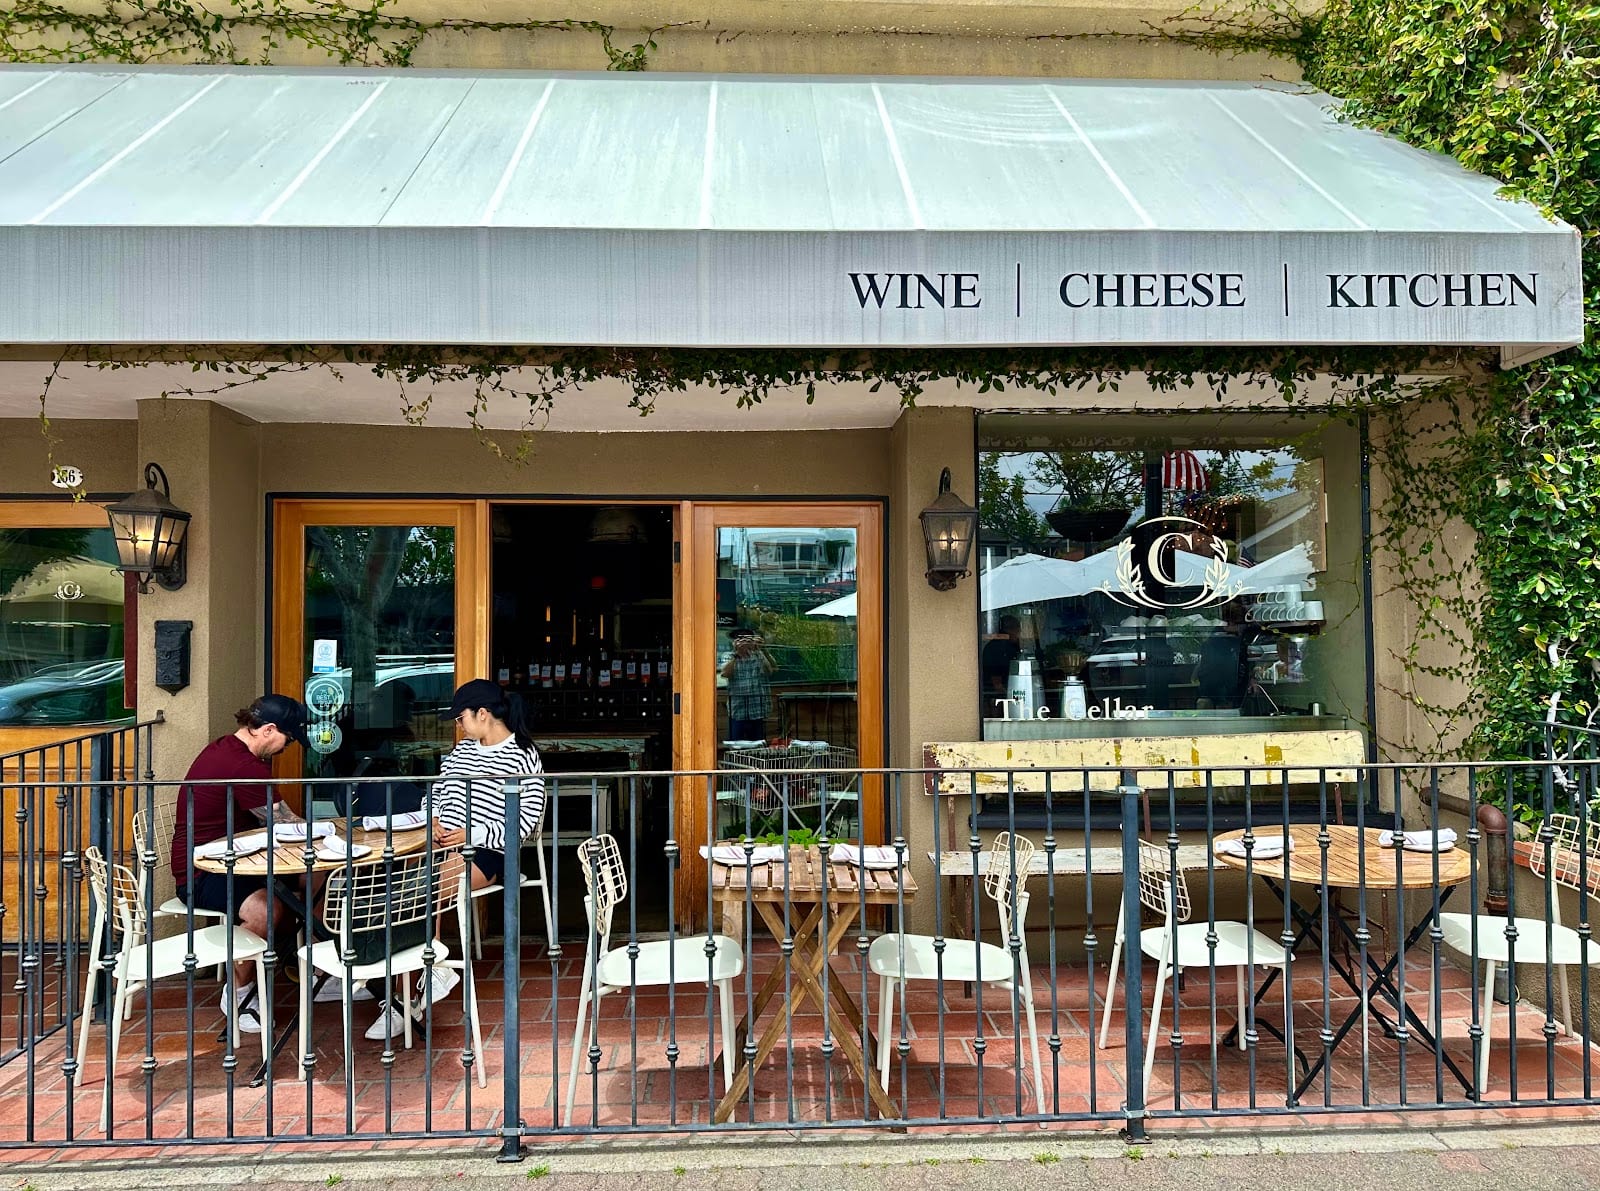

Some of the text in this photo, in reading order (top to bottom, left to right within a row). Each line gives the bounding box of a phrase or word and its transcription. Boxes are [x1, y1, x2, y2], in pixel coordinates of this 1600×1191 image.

[848, 273, 1538, 309] WINE CHEESE KITCHEN
[1147, 532, 1195, 588] C
[995, 697, 1154, 722] The Cellar
